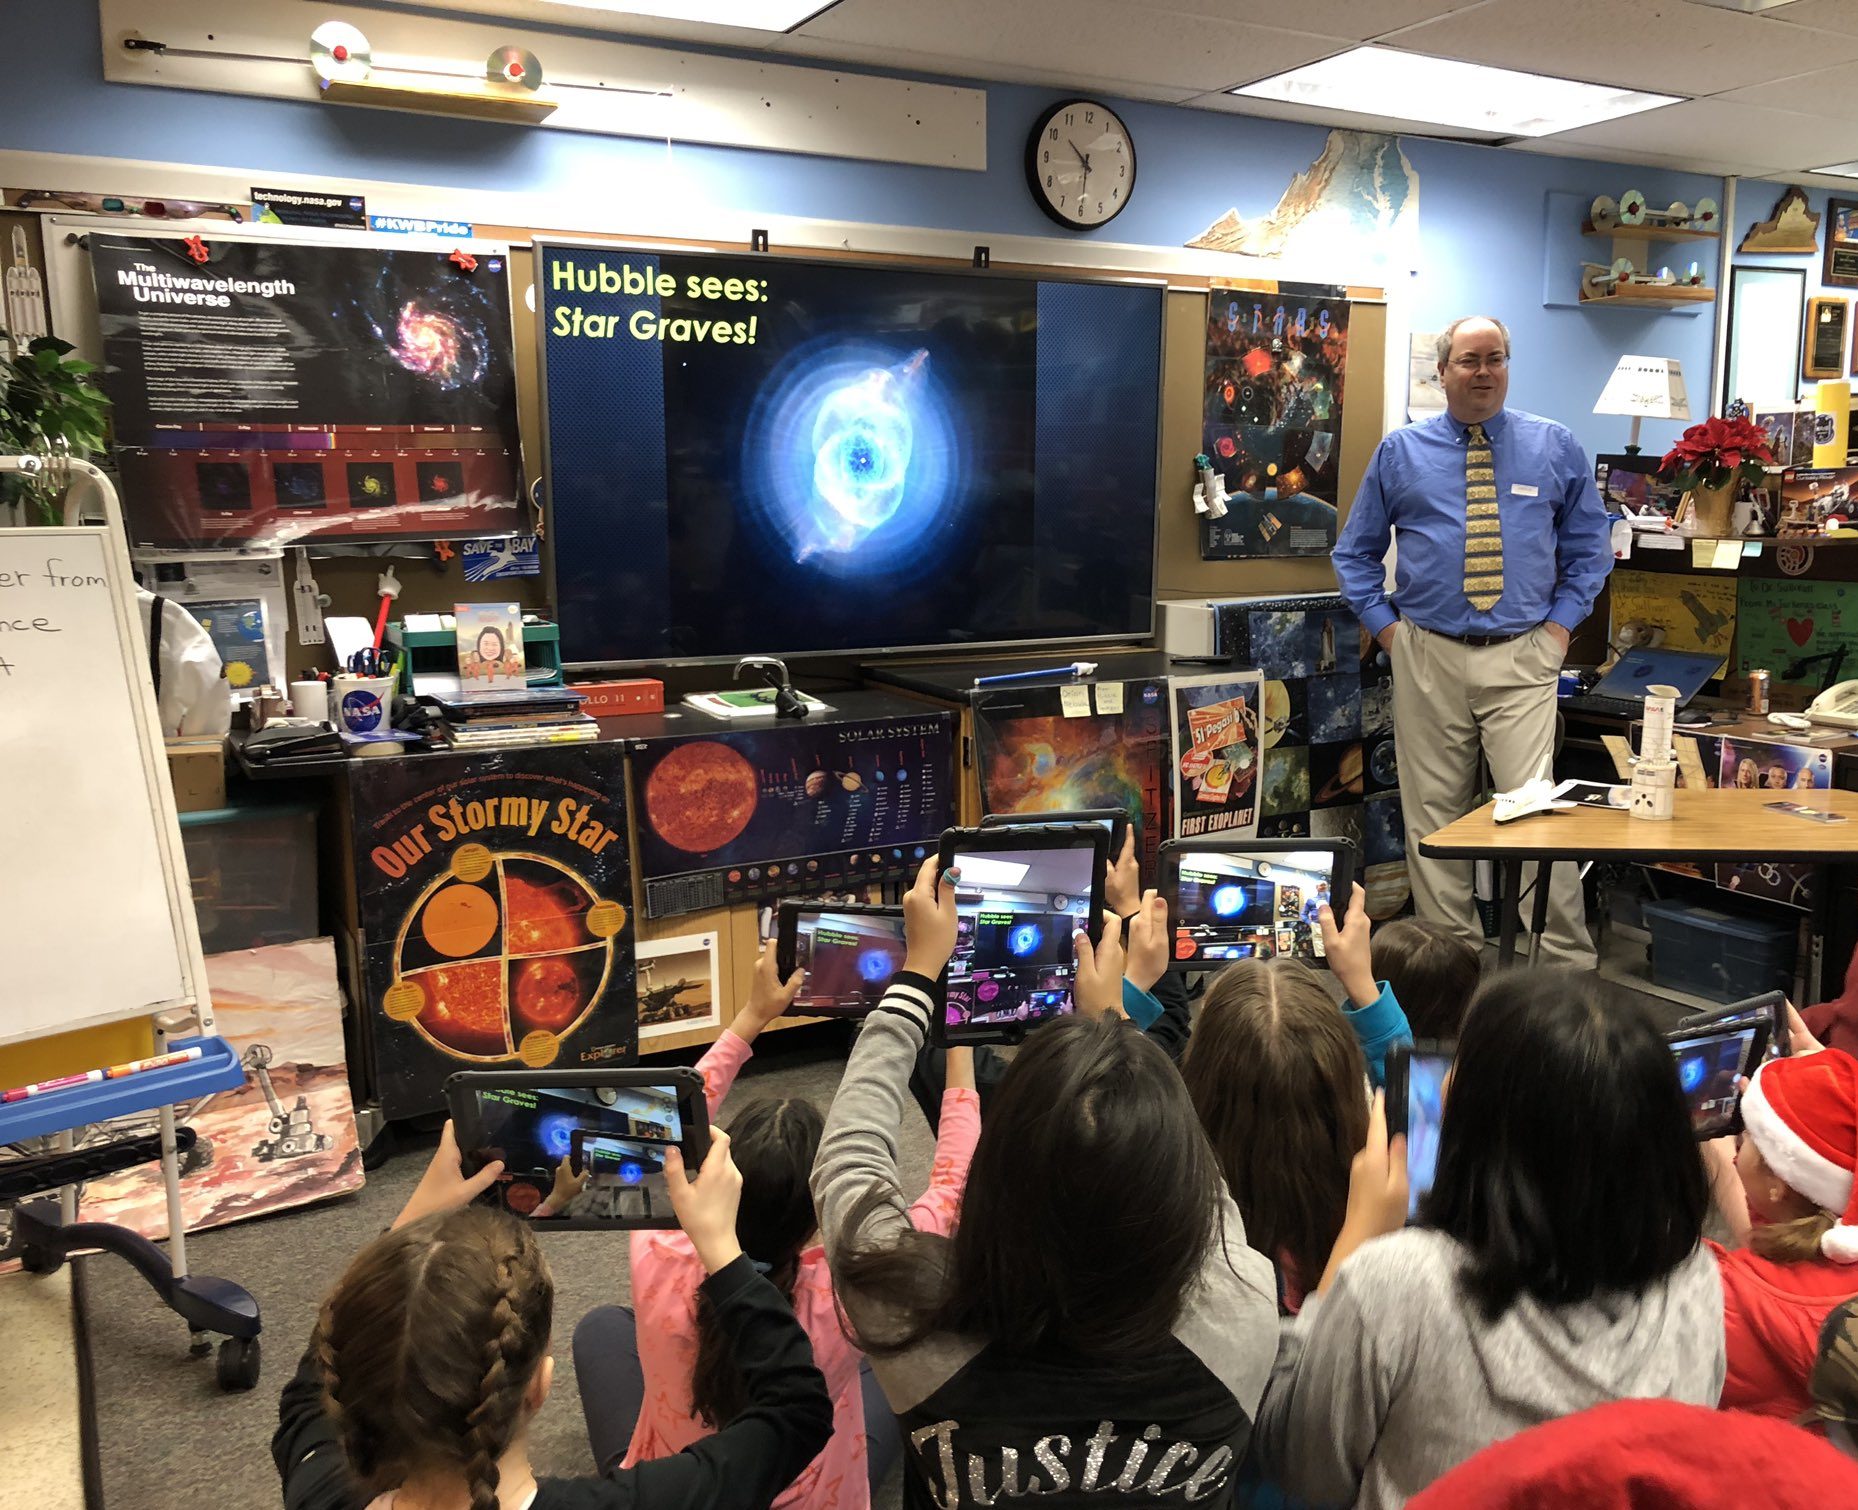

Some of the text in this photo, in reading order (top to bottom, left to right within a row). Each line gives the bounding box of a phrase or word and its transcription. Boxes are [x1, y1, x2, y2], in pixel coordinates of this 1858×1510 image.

[1065, 113, 1074, 126] 11
[1085, 111, 1094, 124] 12
[1049, 128, 1059, 141] 10
[1105, 122, 1109, 133] 1
[1116, 141, 1122, 153] 2
[1043, 150, 1049, 164] 9
[1119, 165, 1125, 178] 3
[1046, 175, 1052, 188] 8
[254, 191, 342, 208] technology.nasa.gov
[1112, 187, 1118, 200] 4
[1060, 195, 1065, 208] 7
[1097, 202, 1103, 214] 5
[1078, 205, 1083, 217] 6
[374, 217, 469, 236] #KWBPride
[133, 262, 157, 273] The
[117, 270, 296, 298] Multiwavelength
[552, 260, 768, 303] Hubble sees:
[133, 286, 231, 308] Universe
[552, 305, 758, 345] Star Graves!
[463, 537, 537, 556] SAVE BAY
[42, 558, 107, 587] from
[343, 705, 381, 718] NASA
[1206, 711, 1233, 738] Pegasi
[839, 723, 940, 743] SOLAR SYSTEM
[514, 772, 544, 780] discover
[1144, 712, 1158, 878] SPITZER
[1181, 815, 1207, 836] FIRST
[1207, 807, 1254, 832] EXOPLANET
[370, 823, 433, 879] Our
[427, 796, 550, 843] Stormy
[550, 797, 620, 855] Star
[482, 1091, 500, 1102] Star
[502, 1095, 537, 1109] Graves!
[910, 1418, 1234, 1510] Justice
